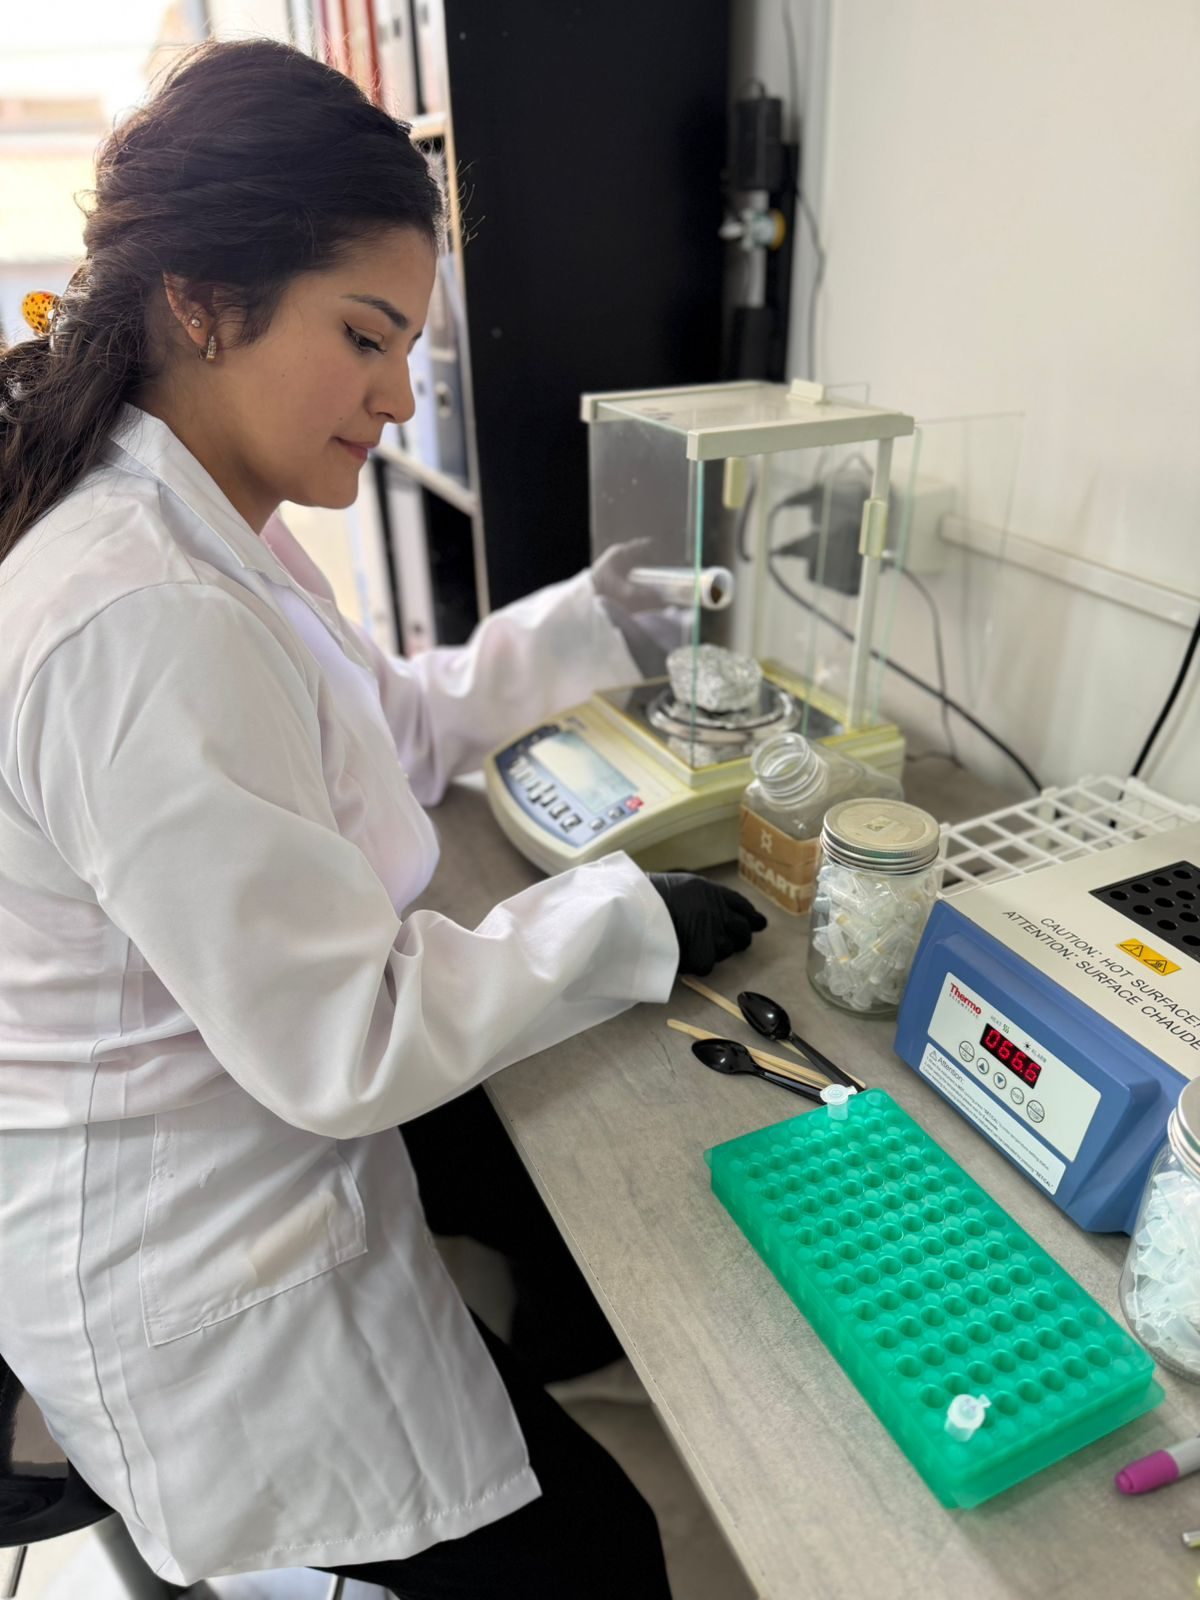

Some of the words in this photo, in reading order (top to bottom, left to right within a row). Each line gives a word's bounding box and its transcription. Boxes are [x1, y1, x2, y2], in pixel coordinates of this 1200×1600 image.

[1040, 917, 1102, 958] CAUTION:
[1099, 957, 1134, 979] HOT
[950, 982, 982, 1015] Thermo
[1002, 911, 1079, 960] ATTENTION:
[1075, 960, 1143, 1005] SURFACE
[1141, 1004, 1200, 1050] CHAUDE
[938, 1057, 965, 1084] Attention:
